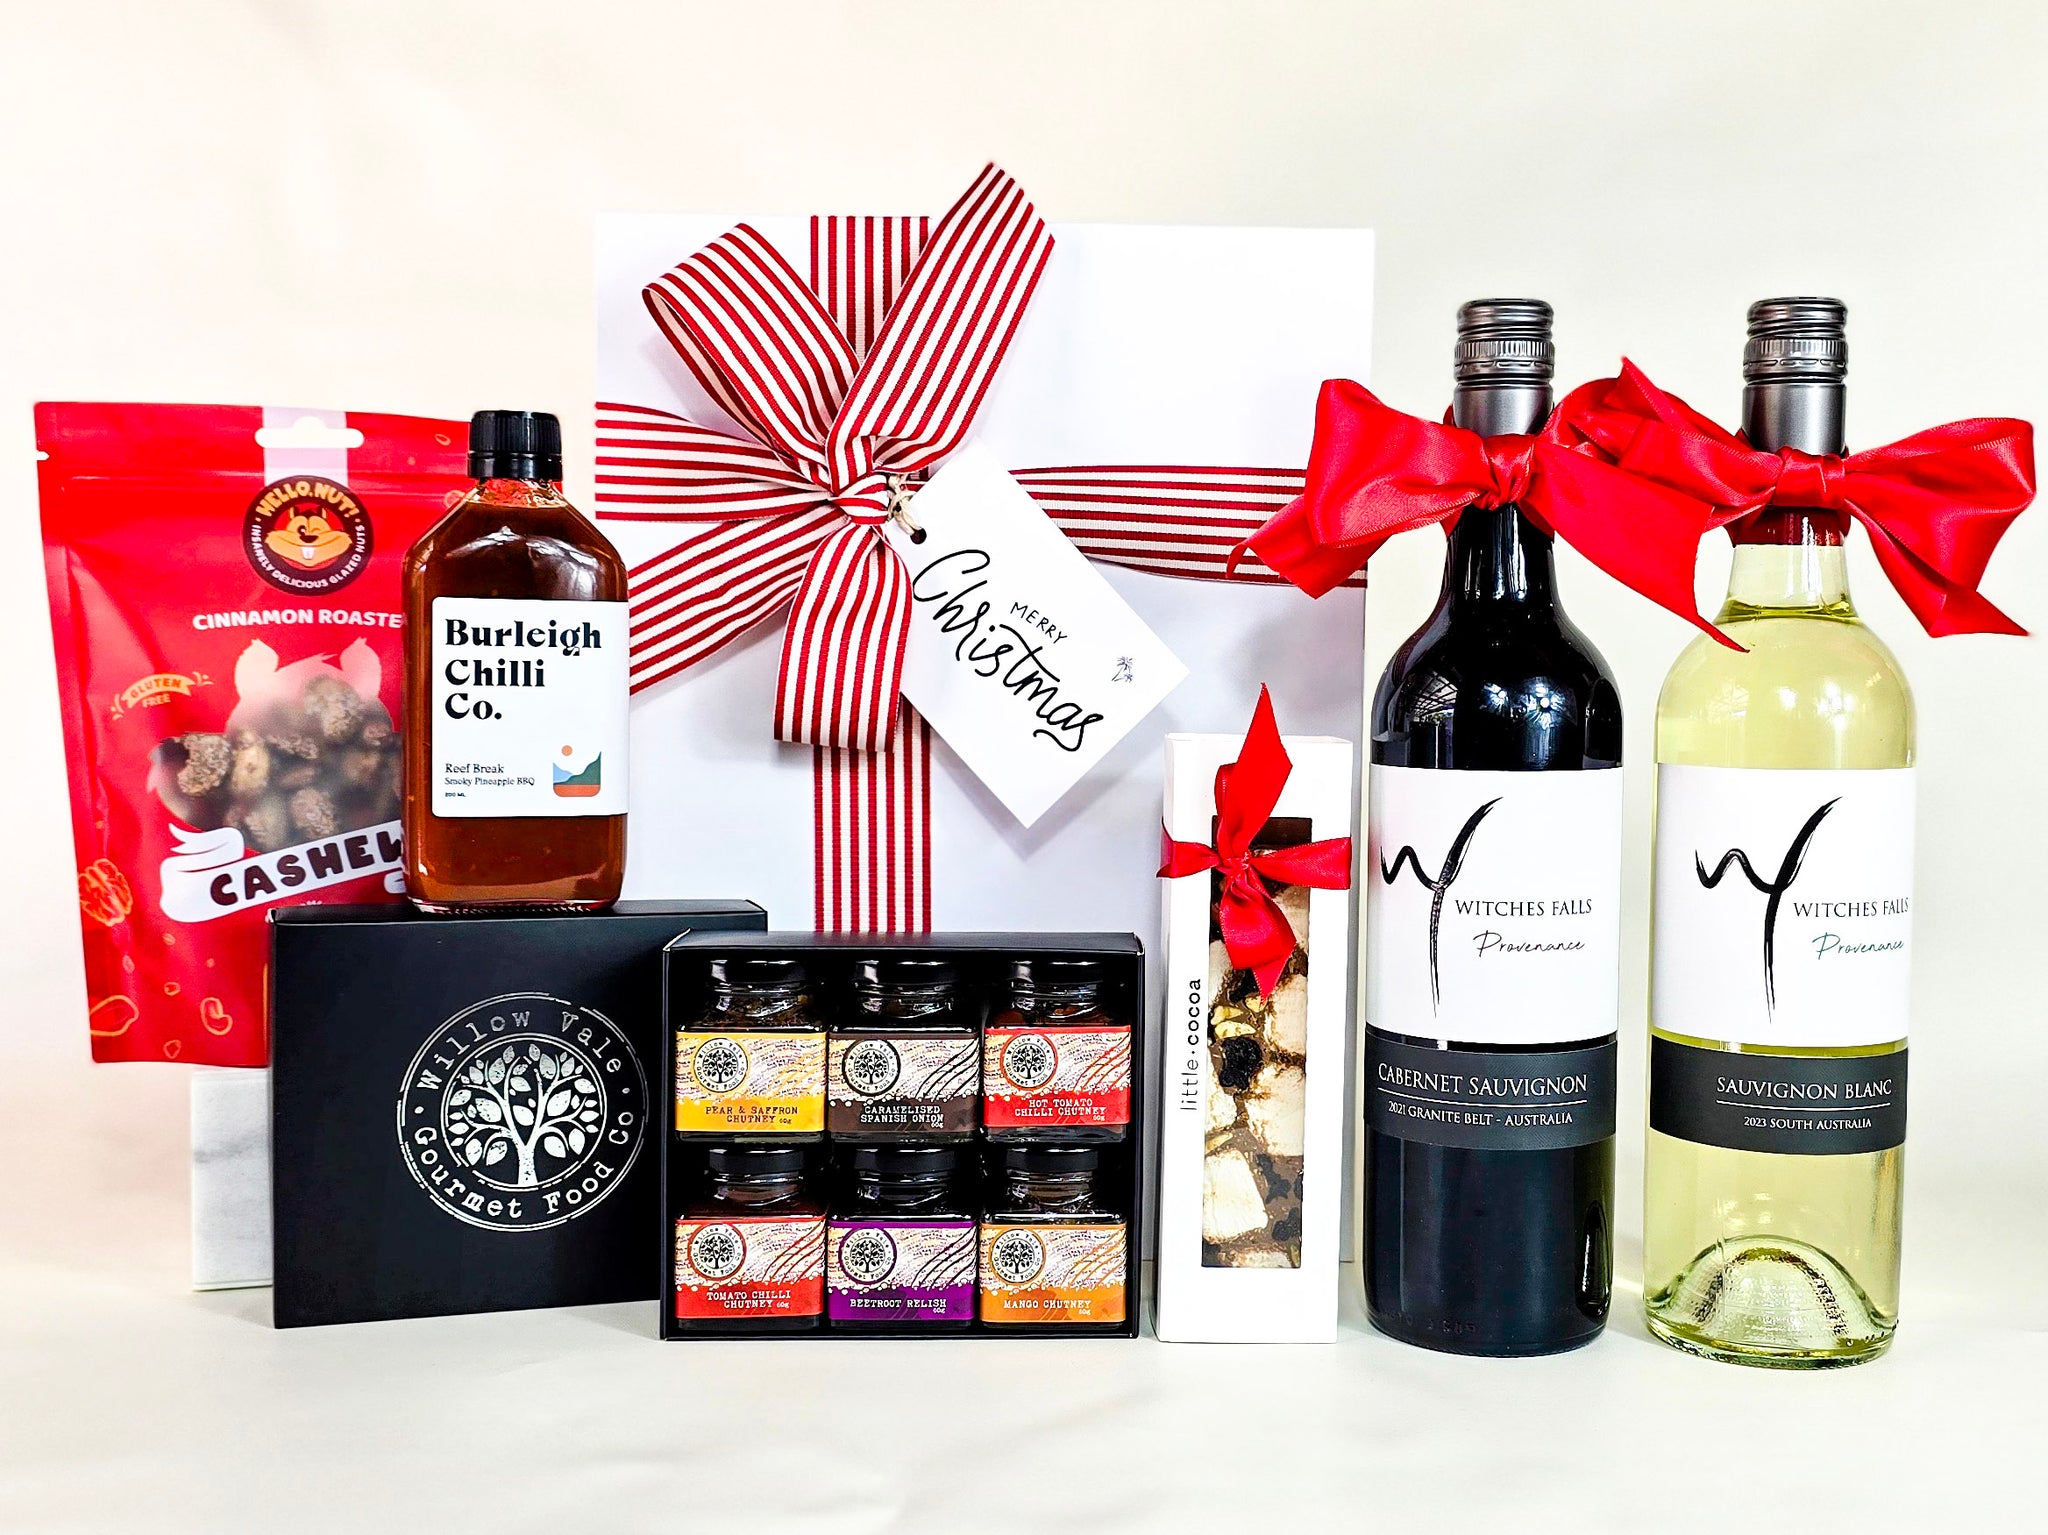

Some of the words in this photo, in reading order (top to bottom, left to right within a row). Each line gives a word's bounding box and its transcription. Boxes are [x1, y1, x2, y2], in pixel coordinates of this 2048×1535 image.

[272, 570, 328, 588] DELICIOUS
[329, 554, 362, 584] GLAZED
[356, 524, 366, 553] NUTS
[192, 609, 313, 630] CINNAMON
[318, 609, 402, 628] ROASTE
[1010, 601, 1068, 644] MERRY
[445, 618, 602, 656] Burleigh
[912, 549, 1104, 752] Christmas
[445, 658, 546, 688] Chilli
[130, 678, 182, 698] GLUTEN
[445, 692, 502, 720] Co.
[445, 763, 471, 774] Reef
[473, 763, 505, 774] Break
[444, 777, 473, 787] Smoky
[475, 777, 515, 787] Pineapple
[516, 778, 536, 786] BBQ
[1455, 900, 1545, 916] WITCHES
[1552, 898, 1592, 916] FALLS
[1794, 901, 1878, 918] WITCHES
[1883, 897, 1909, 915] FALLS
[1473, 930, 1585, 958] Provenance
[416, 1011, 531, 1090] Willow
[562, 1011, 622, 1073] Vale
[1378, 1062, 1463, 1094] CABERNET
[1469, 1074, 1588, 1096] SAUVIGNON
[1716, 1076, 1838, 1100] SAUVIGNON
[1844, 1079, 1892, 1099] BLANC
[706, 1106, 732, 1114] PEAR
[739, 1106, 746, 1114] &
[750, 1106, 798, 1114] SAFFRON
[864, 1106, 940, 1114] CARAMELISED
[1014, 1108, 1054, 1116] CHILLI
[1058, 1106, 1106, 1116] CHUTNEY
[1029, 1099, 1048, 1108] HOT
[1053, 1098, 1092, 1107] TOMATO
[1388, 1100, 1406, 1114] 2021
[1408, 1105, 1460, 1124] GRANITE
[1464, 1114, 1494, 1126] BELT
[1504, 1112, 1573, 1126] AUSTRALIA
[726, 1115, 776, 1123] CHUTNEY
[860, 1114, 907, 1123] SPANISH
[912, 1114, 944, 1123] ONION
[1744, 1116, 1767, 1127] 2023
[1770, 1118, 1812, 1130] SOUTH
[1816, 1118, 1872, 1130] AUSTRALIA
[414, 1126, 523, 1218] Gourmet
[543, 1160, 614, 1214] Food
[608, 1112, 634, 1145] Co
[706, 1292, 748, 1300] TOMATO
[752, 1290, 791, 1299] CHILLI
[724, 1300, 774, 1308] CHUTNEY
[850, 1298, 902, 1308] BEETROOT
[906, 1298, 947, 1308] RELISH
[1003, 1300, 1038, 1308] MANGO
[1043, 1300, 1091, 1308] CHUTNEY
